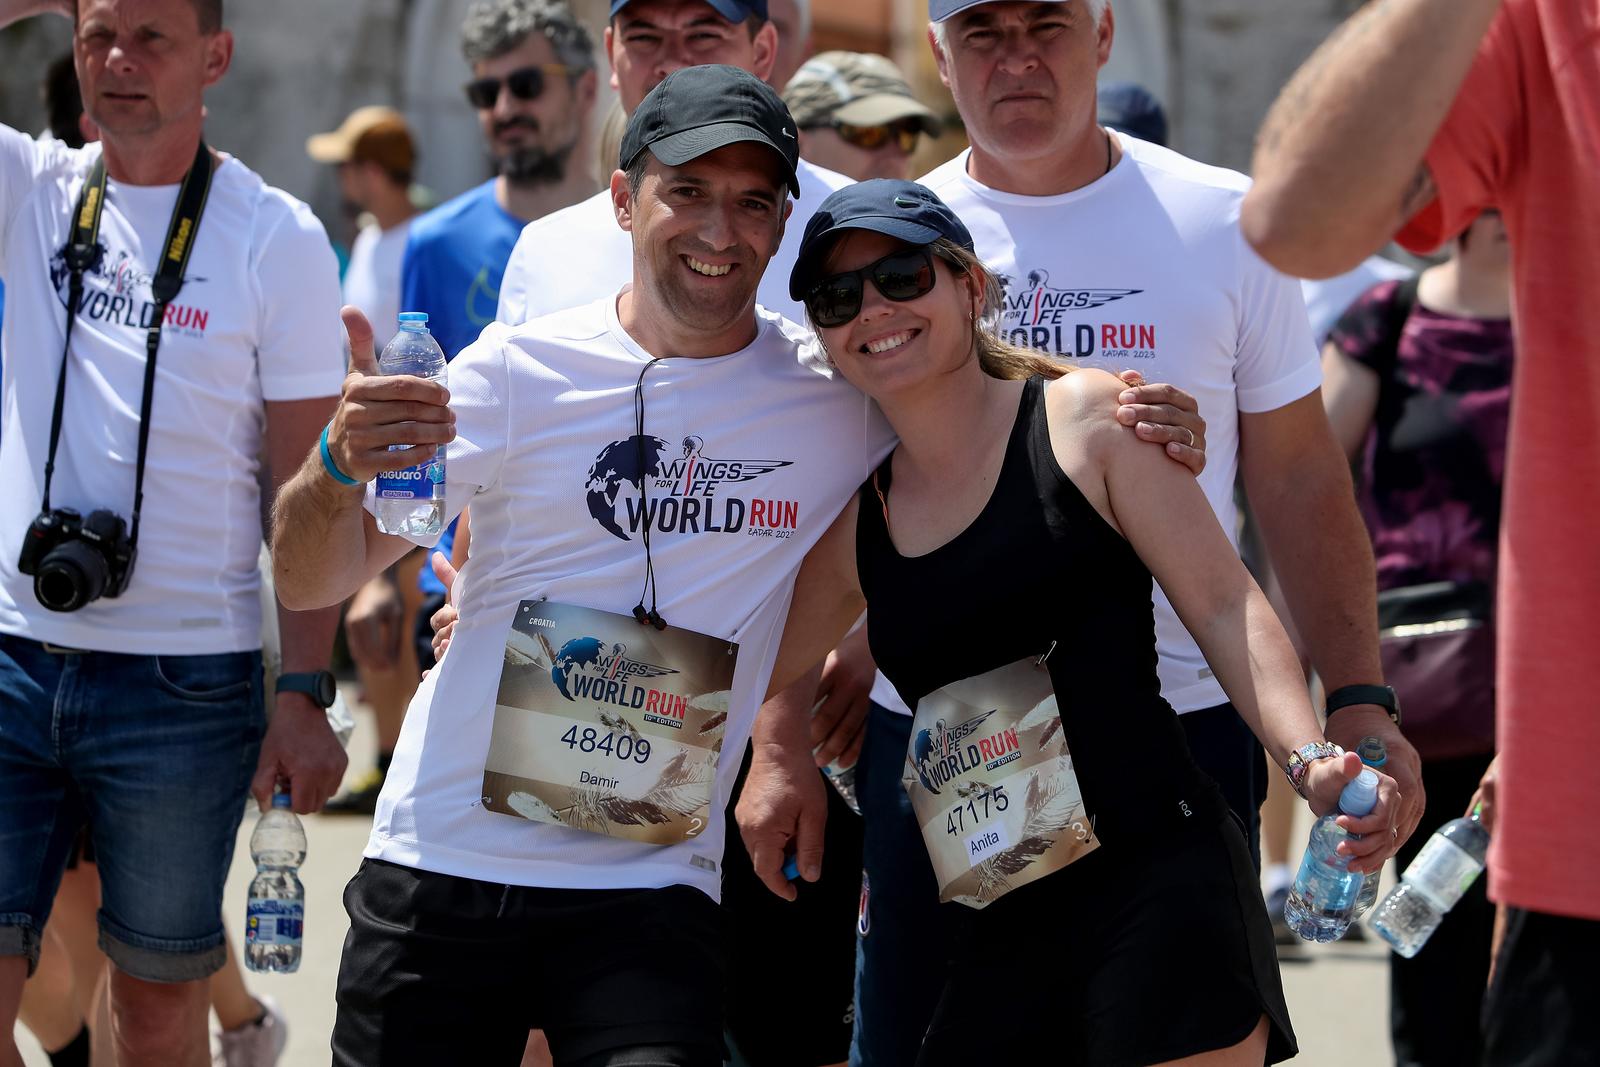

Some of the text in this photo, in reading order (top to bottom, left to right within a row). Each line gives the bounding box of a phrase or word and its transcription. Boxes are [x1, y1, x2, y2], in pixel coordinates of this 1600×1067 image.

[79, 186, 99, 229] Nikon
[169, 217, 192, 261] Nikon
[1008, 288, 1090, 310] WINGS
[160, 303, 209, 331] RUN
[1004, 309, 1066, 326] FOR LIFE
[1001, 324, 1155, 358] ORLD RUN
[1134, 350, 1155, 359] 2023
[661, 457, 743, 479] WINGS
[654, 480, 720, 497] FOR LIFE
[625, 497, 799, 534] WORLD RUN
[528, 617, 556, 629] CROATIA
[593, 665, 632, 683] FOR LIFE
[598, 656, 648, 675] WINGS
[574, 674, 688, 720] WORLD RUN
[657, 716, 682, 729] EDITION
[561, 725, 652, 764] 48409
[931, 723, 969, 750] WINGS
[929, 727, 1020, 789] WORLD RUN
[940, 740, 961, 759] LIFE
[997, 751, 1021, 766] EDITION
[579, 771, 620, 790] Damir
[946, 785, 1009, 837] 47175
[686, 817, 702, 835] 2
[1072, 822, 1087, 841] 3
[970, 831, 1000, 855] Anita
